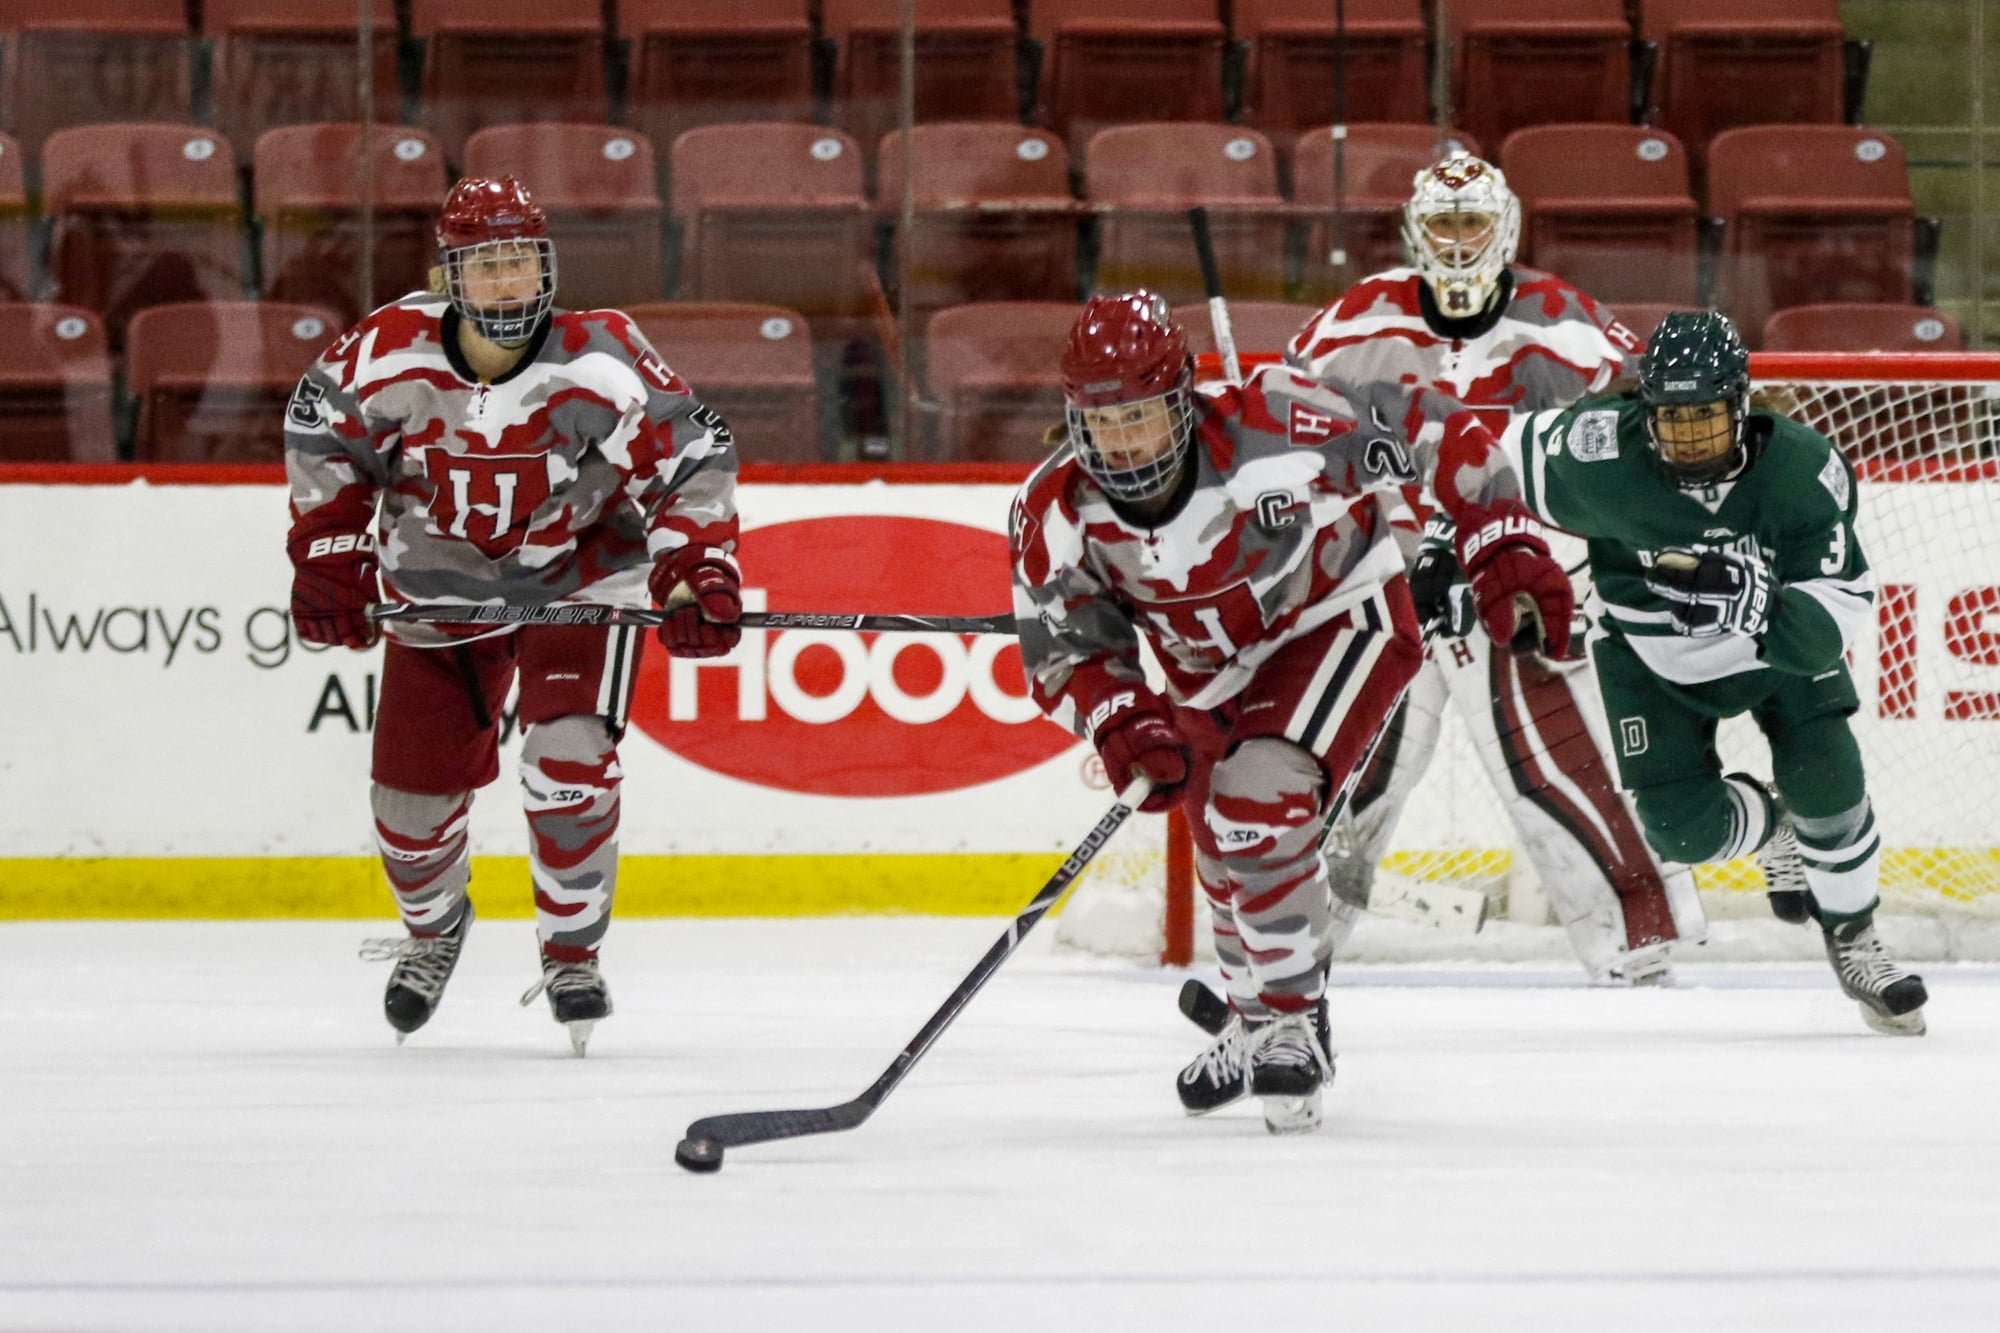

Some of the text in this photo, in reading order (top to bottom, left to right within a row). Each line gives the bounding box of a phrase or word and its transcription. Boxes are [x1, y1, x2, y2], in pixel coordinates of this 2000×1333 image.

[1295, 409, 1332, 437] H
[448, 469, 516, 541] H
[1256, 489, 1295, 531] C
[307, 533, 375, 560] BAU
[1463, 516, 1545, 565] BAUE
[1820, 521, 1846, 576] 3
[764, 613, 854, 629] SUPREME
[1449, 638, 1475, 669] H
[1619, 716, 1648, 758] D
[1062, 802, 1132, 877] BAUER
